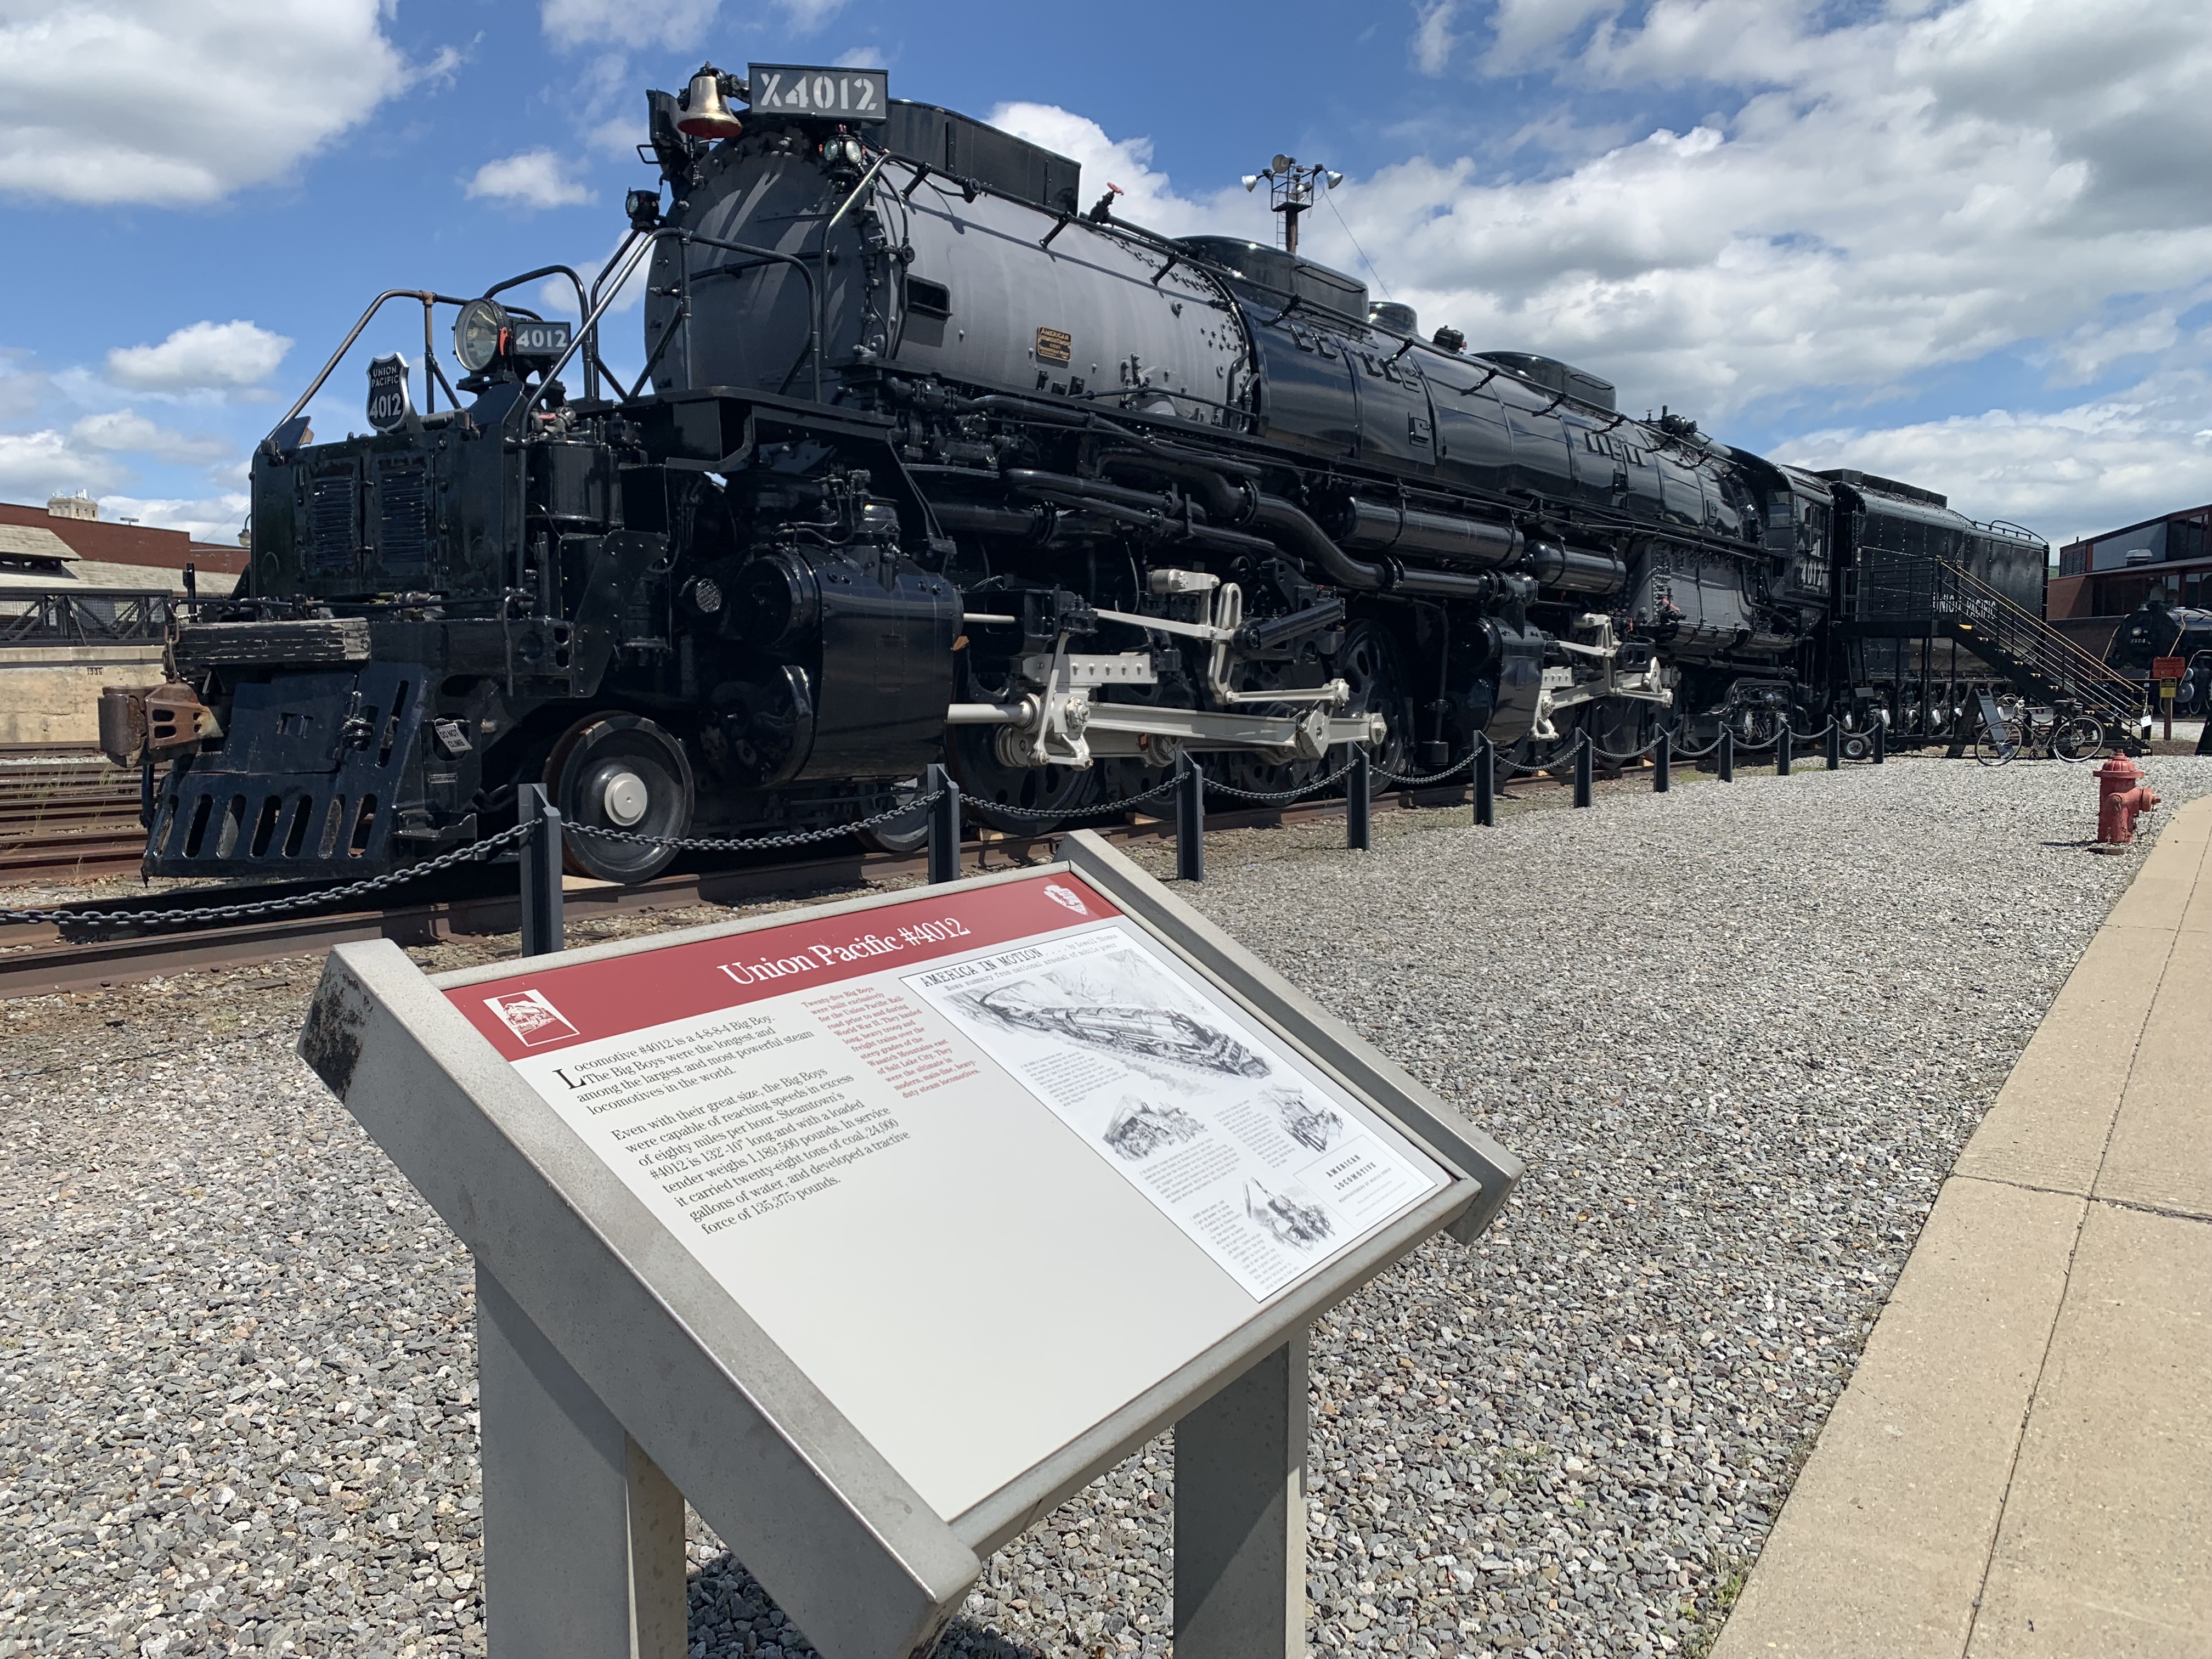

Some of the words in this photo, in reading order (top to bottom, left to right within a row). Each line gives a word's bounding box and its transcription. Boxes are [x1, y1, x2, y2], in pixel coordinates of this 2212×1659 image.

[760, 73, 877, 111] X4012
[516, 329, 568, 348] 4012
[371, 374, 399, 388] PACIFIC
[373, 364, 397, 377] UNION
[369, 392, 402, 418] 4012
[1801, 562, 1822, 586] 4012
[447, 729, 459, 737] NOT
[448, 739, 465, 748] CLIMB
[716, 956, 819, 984] Union
[808, 935, 904, 966] Pacific
[897, 918, 971, 946] #4012
[920, 965, 979, 987] AMERICA
[977, 960, 997, 971] IN
[996, 949, 1043, 966] MOTION
[801, 995, 845, 1008] Twenty-five
[842, 1007, 866, 1015] Union
[864, 1001, 889, 1010] Pacific
[848, 992, 885, 1005] exclusively
[827, 1020, 845, 1030] road
[844, 1017, 863, 1026] prior
[885, 1004, 909, 1013] during
[833, 1026, 858, 1036] World
[898, 1008, 923, 1019] hauled
[638, 1040, 674, 1054] #4012
[672, 1037, 686, 1046] is
[695, 1024, 731, 1039] 4-8-8-4
[729, 1021, 753, 1030] Big
[748, 1016, 775, 1025] Boy.
[842, 1036, 863, 1045] long,
[860, 1030, 883, 1039] heavy
[882, 1025, 902, 1033] troop
[851, 1041, 877, 1052] freight
[876, 1035, 898, 1045] trains
[583, 1073, 611, 1084] The
[609, 1065, 636, 1077] Big
[631, 1058, 665, 1071] Boys
[665, 1050, 696, 1062] were
[695, 1045, 715, 1054] the
[713, 1033, 755, 1048] longest
[755, 1026, 776, 1037] and
[860, 1051, 880, 1059] steep
[880, 1043, 904, 1054] grades
[866, 1054, 899, 1066] Wasatch
[896, 1044, 934, 1058] Mountains
[884, 1064, 901, 1072] Salt
[899, 1059, 918, 1067] Lake
[934, 1048, 952, 1056] They
[577, 1084, 623, 1102] among
[620, 1079, 642, 1090] the
[640, 1066, 685, 1084] largest
[684, 1059, 708, 1071] and
[706, 1052, 737, 1065] most
[735, 1037, 784, 1059] powerful
[783, 1031, 815, 1043] steam
[586, 1088, 664, 1115] locomotives
[662, 1084, 679, 1092] in
[678, 1079, 699, 1088] the
[699, 1066, 736, 1081] world.
[610, 1125, 648, 1141] Even
[647, 1115, 677, 1129] with
[676, 1106, 706, 1120] their
[707, 1096, 738, 1113] great
[737, 1090, 764, 1101] size,
[762, 1084, 782, 1093] the
[779, 1076, 803, 1087] Big
[798, 1069, 827, 1081] Boys
[625, 1138, 658, 1153] were
[659, 1122, 707, 1142] capable
[707, 1115, 722, 1126] of
[721, 1101, 772, 1122] reaching
[770, 1089, 808, 1107] speeds
[805, 1086, 820, 1094] in
[820, 1075, 854, 1090] excess
[639, 1154, 654, 1166] of
[654, 1143, 692, 1161] eighty
[692, 1132, 727, 1148] miles
[726, 1125, 747, 1139] per
[744, 1116, 778, 1130] hour.
[650, 1160, 689, 1180] #4012
[686, 1158, 702, 1167] is
[745, 1132, 776, 1146] long
[774, 1122, 797, 1137] and
[795, 1115, 822, 1128] with
[827, 1099, 865, 1118] loaded
[662, 1173, 705, 1193] tender
[705, 1159, 748, 1177] weighs
[747, 1138, 800, 1163] 1,189,500
[799, 1125, 843, 1147] pounds.
[839, 1120, 856, 1129] In
[855, 1108, 890, 1125] service
[674, 1197, 689, 1207] it
[689, 1179, 734, 1202] carried
[732, 1154, 805, 1186] twenty-eight
[803, 1146, 829, 1160] tons
[829, 1138, 842, 1150] of
[842, 1131, 869, 1145] coal,
[865, 1119, 899, 1136] 24,000
[1325, 1154, 1361, 1178] AMERICAN
[1334, 1161, 1377, 1190] LOCOMOTIVE
[690, 1199, 735, 1223] gallons
[736, 1190, 751, 1203] of
[749, 1180, 789, 1197] water,
[787, 1168, 811, 1183] and
[810, 1147, 865, 1175] developed
[871, 1132, 910, 1150] tractive
[701, 1217, 737, 1234] force
[737, 1207, 752, 1220] of
[751, 1191, 795, 1215] 135,375
[795, 1177, 840, 1200] pounds.
